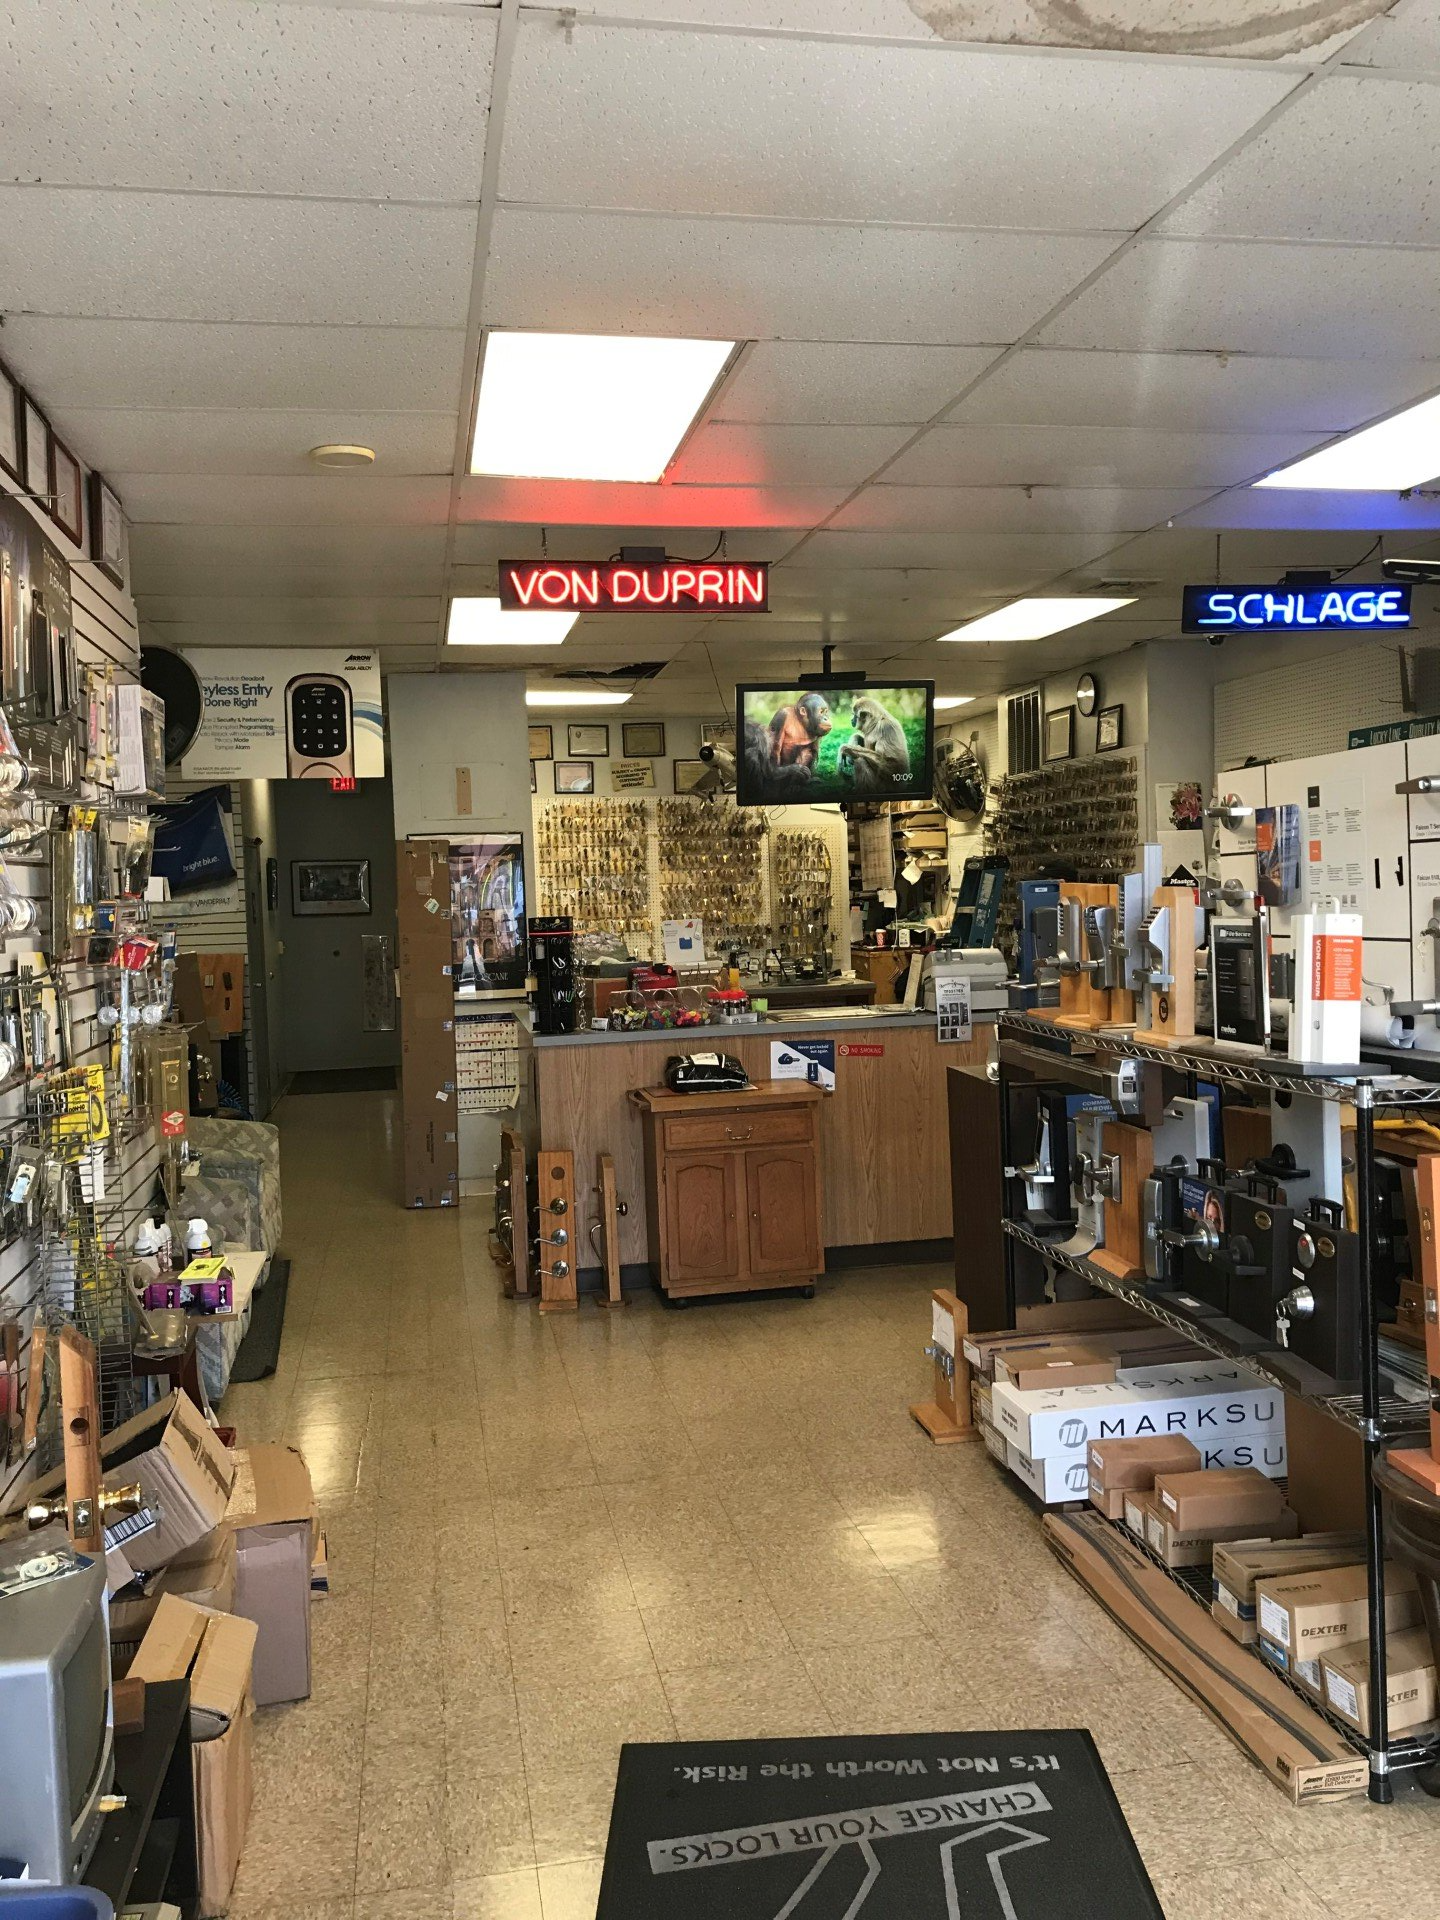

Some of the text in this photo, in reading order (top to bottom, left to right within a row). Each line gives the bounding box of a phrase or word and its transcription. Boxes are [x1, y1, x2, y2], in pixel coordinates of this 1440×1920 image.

[511, 570, 762, 604] VON DUPRIN
[1198, 591, 1410, 624] SCHLAGE
[344, 654, 372, 662] ARROW
[242, 684, 273, 698] Entry
[204, 698, 258, 709] Done Right
[1370, 729, 1388, 745] LUCKY
[1389, 726, 1401, 742] LINE
[1409, 721, 1435, 739] QUALITY
[892, 773, 913, 781] 10:09
[332, 778, 355, 791] EXIT
[183, 856, 220, 873] bright blue.
[195, 897, 231, 908] VANDERBILT
[1172, 1539, 1213, 1548] DEXTER
[1276, 1584, 1322, 1592] DEXTER
[1301, 1624, 1347, 1637] DEXTER
[673, 1755, 1060, 1783] It's Not Worth the Risk.
[660, 1791, 1036, 1865] CHANGE YOUR LOCKS.
